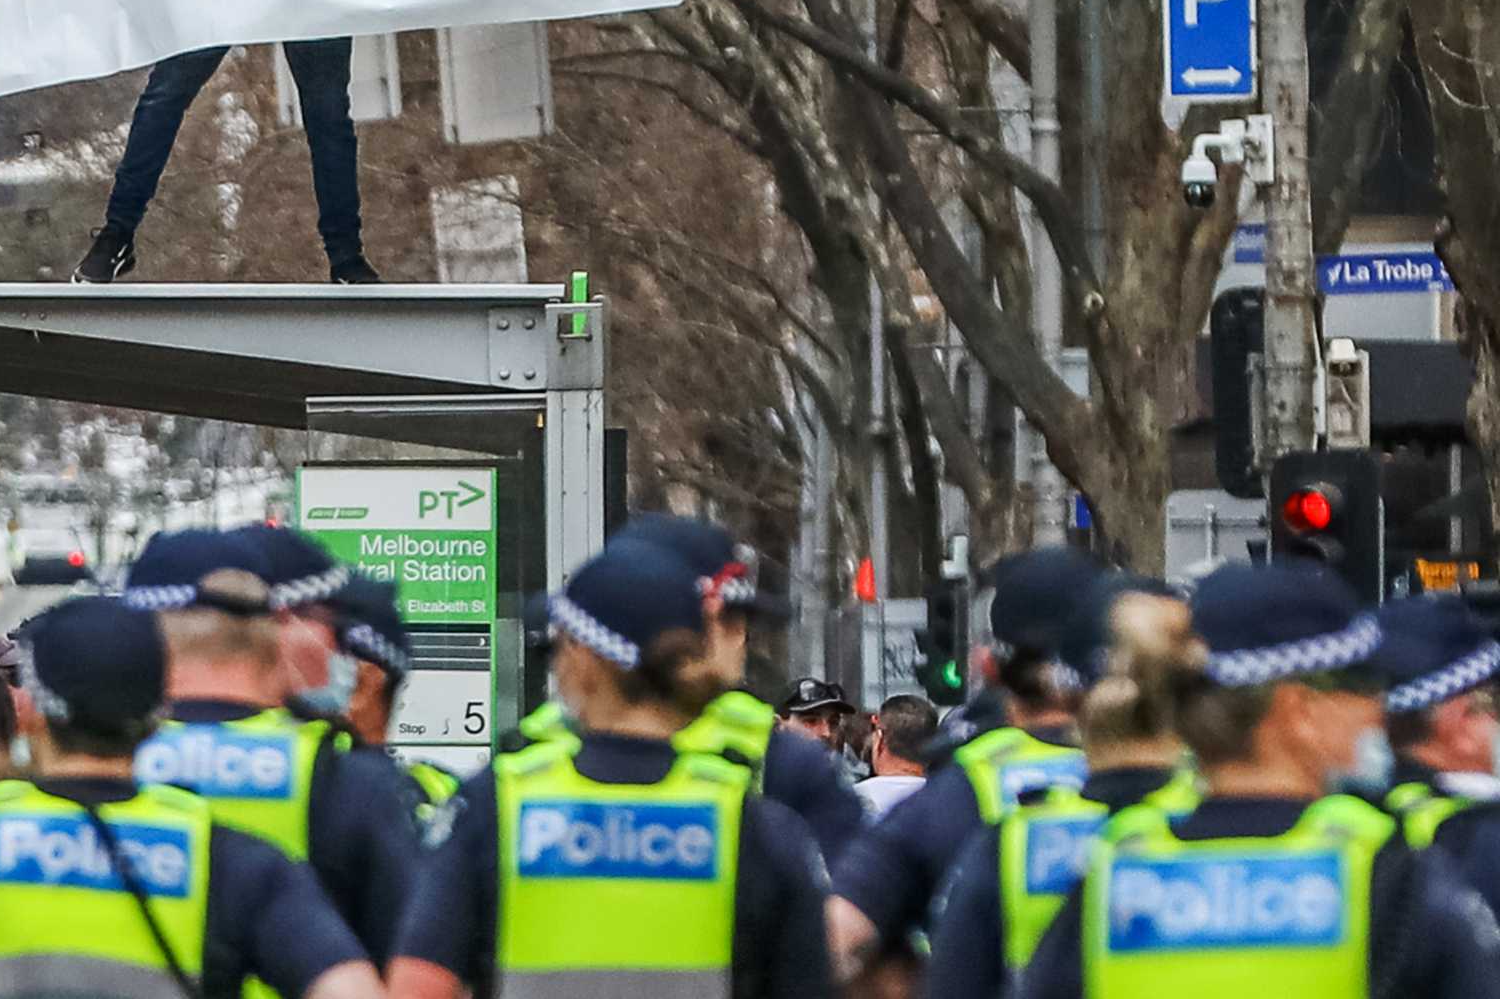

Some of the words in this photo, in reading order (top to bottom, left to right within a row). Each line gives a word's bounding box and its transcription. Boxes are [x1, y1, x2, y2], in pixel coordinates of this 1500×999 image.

[1343, 260, 1370, 283] La
[1372, 258, 1434, 282] Trobe
[360, 534, 487, 556] Melbourne
[357, 559, 395, 582] tral
[403, 559, 486, 582] Station
[471, 600, 486, 613] St
[398, 722, 427, 736] Stop
[464, 701, 485, 735] 5
[132, 728, 287, 789] olice
[520, 803, 714, 867] Police
[1112, 864, 1342, 938] Police
